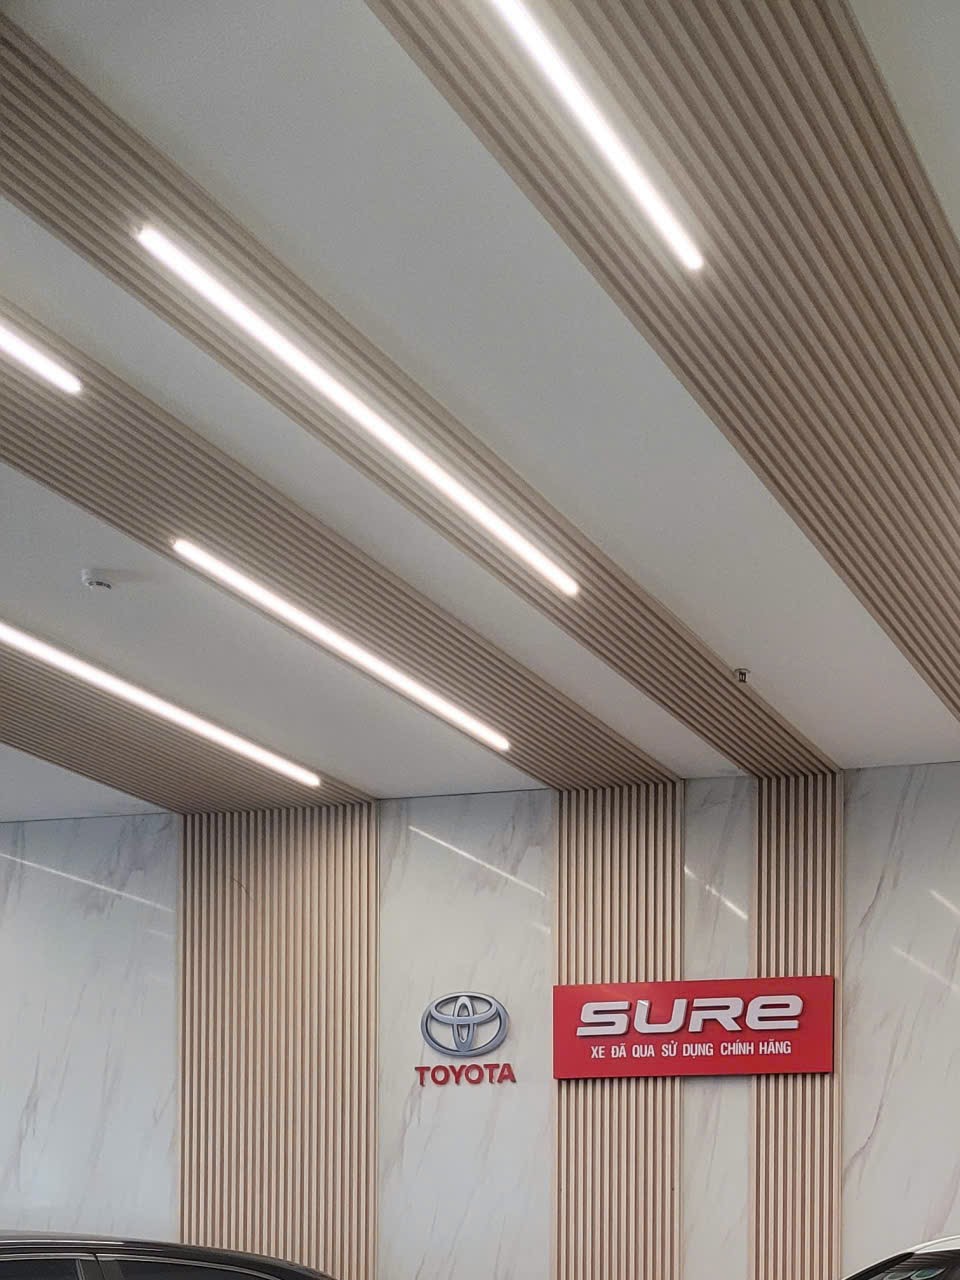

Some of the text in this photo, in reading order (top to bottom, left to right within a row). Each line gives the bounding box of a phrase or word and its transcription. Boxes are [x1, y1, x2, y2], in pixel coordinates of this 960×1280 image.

[590, 1038, 791, 1060] XE ĐÃ QUA SỬ DỤNG CHÍNH HÃNG
[415, 1063, 517, 1088] TOYOTA
